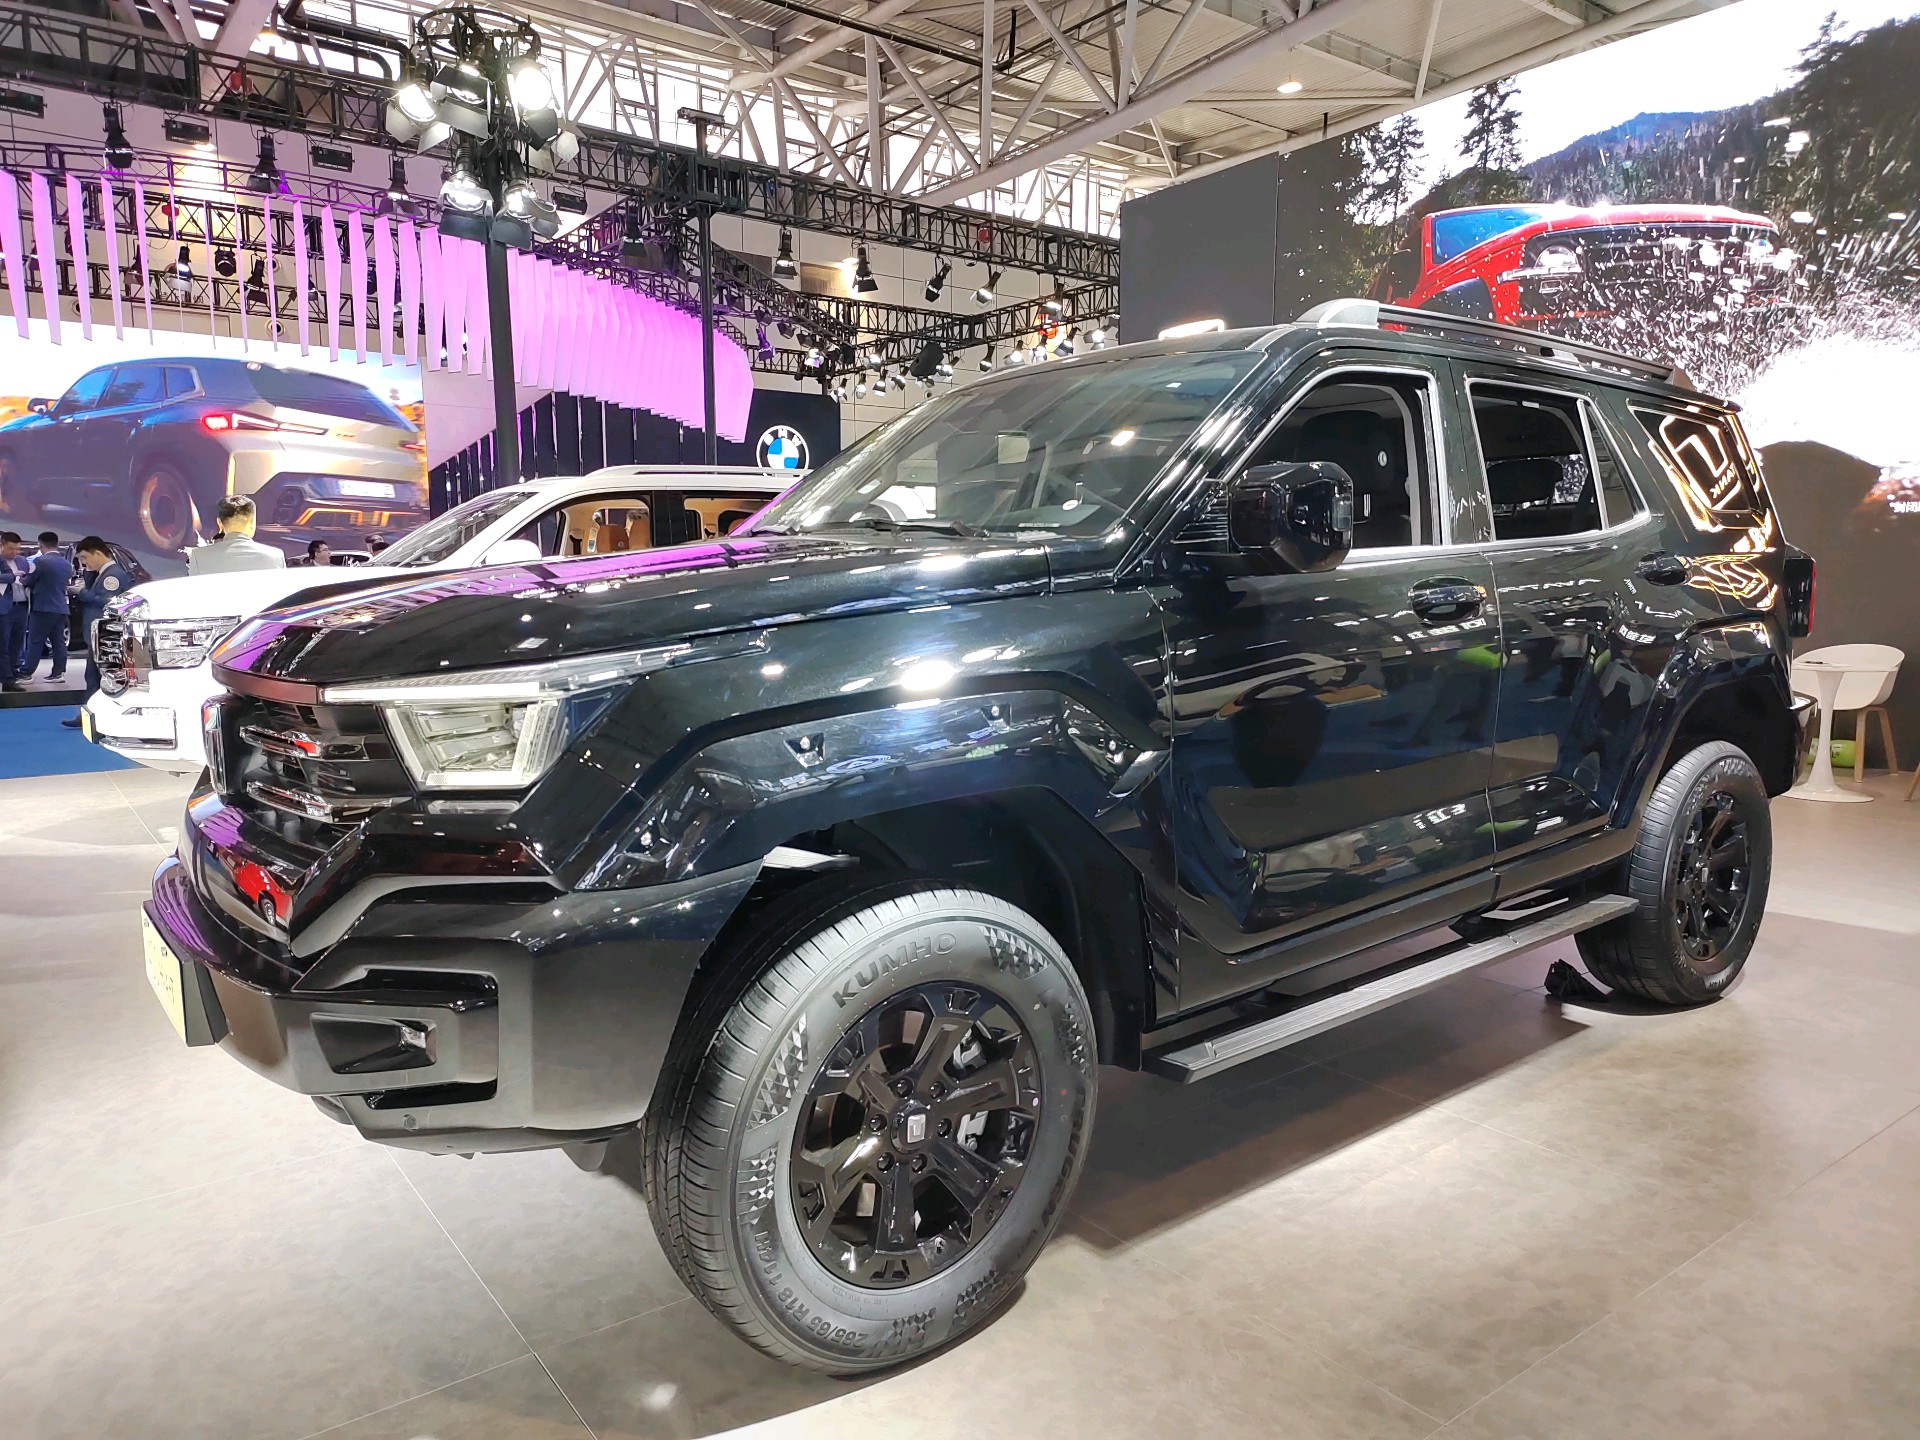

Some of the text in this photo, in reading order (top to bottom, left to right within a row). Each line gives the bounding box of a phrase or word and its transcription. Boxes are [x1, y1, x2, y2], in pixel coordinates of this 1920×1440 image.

[832, 933, 956, 1008] KUMHO
[778, 1287, 810, 1322] R18
[806, 1316, 868, 1348] 265/65
